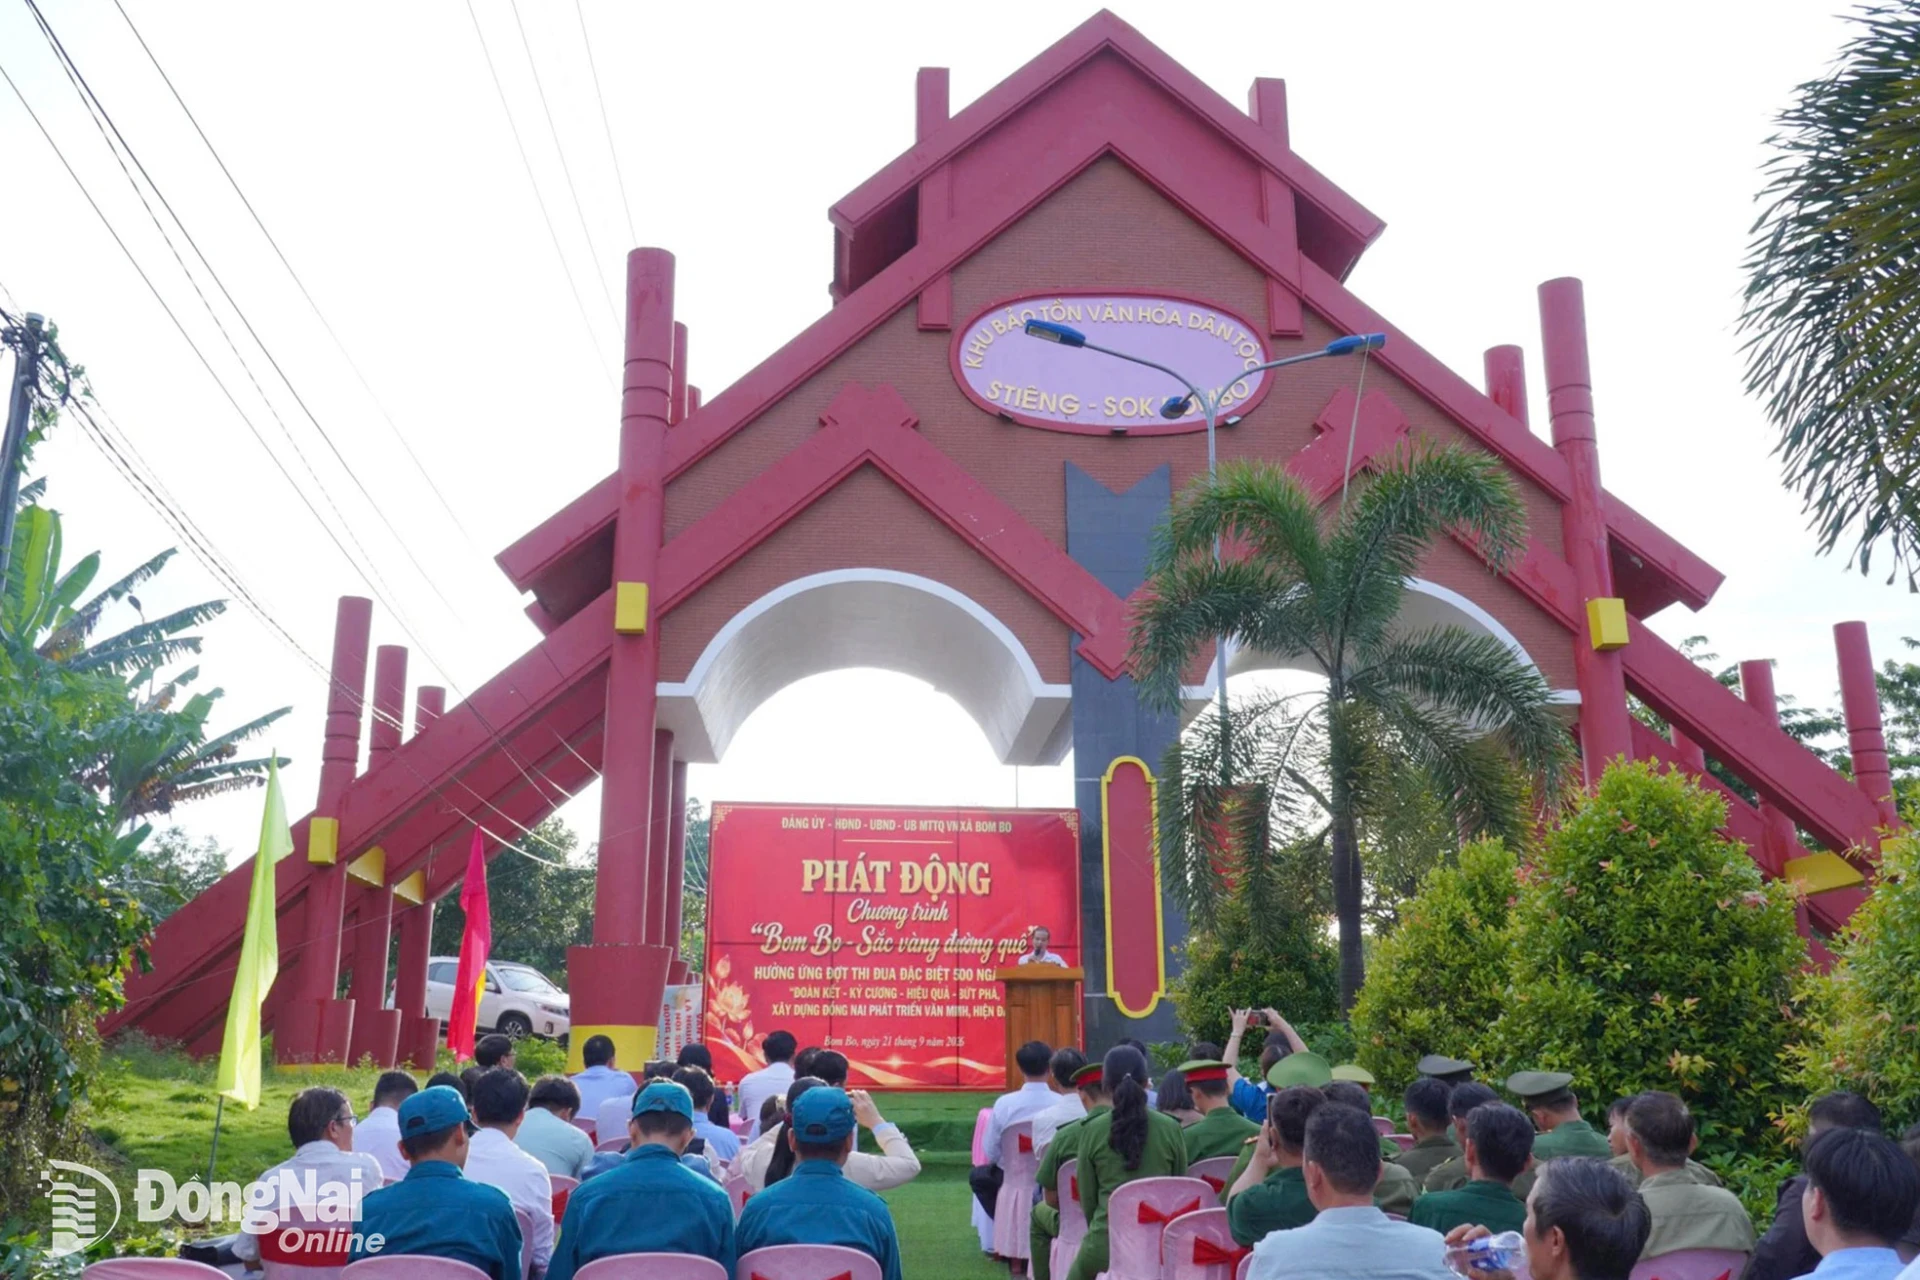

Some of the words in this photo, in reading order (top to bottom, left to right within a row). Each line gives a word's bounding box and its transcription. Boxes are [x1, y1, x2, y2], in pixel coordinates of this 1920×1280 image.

[965, 327, 994, 369] KHU
[991, 305, 1036, 336] BẢO
[1087, 301, 1134, 323] VĂN
[1137, 302, 1183, 327] HÓA
[1187, 311, 1235, 342] DÂN
[1230, 332, 1261, 371] TỘC
[985, 379, 1080, 416] STIÊNG
[1104, 396, 1154, 417] SOK
[782, 814, 809, 829] ĐẢNG
[812, 814, 825, 829] ỦY
[835, 818, 861, 830] HĐND
[870, 819, 895, 830] UBND
[904, 820, 917, 831] UB
[919, 821, 944, 832] MTTQ
[947, 821, 958, 832] VN
[960, 818, 972, 832] XÃ
[975, 821, 996, 832] BOM
[999, 822, 1012, 832] BO
[801, 852, 891, 893] PHÁT
[900, 853, 991, 902] ĐỘNG
[847, 898, 909, 929] Chương
[912, 901, 949, 921] trình
[751, 922, 808, 954] “Bom
[811, 924, 842, 956] Bo
[856, 925, 893, 956] Sắc
[898, 932, 941, 963] vàng
[944, 928, 995, 964] đường
[754, 962, 795, 980] HƯỞNG
[798, 964, 822, 980] ỨNG
[826, 966, 848, 983] ĐỢT
[851, 967, 870, 980] THI
[873, 968, 896, 980] ĐUA
[900, 965, 922, 983] ĐẶC
[925, 965, 950, 984] BIỆT
[953, 968, 973, 981] 500
[822, 984, 840, 998] KẾT
[865, 986, 897, 999] CƯƠNG
[906, 986, 928, 1001] HIỆU
[930, 985, 950, 1001] QUẢ
[959, 986, 976, 999] BỨT
[772, 1001, 792, 1016] XÂY
[794, 1003, 820, 1018] DỰNG
[822, 1001, 848, 1016] ĐỒNG
[850, 1004, 867, 1016] NAI
[869, 1002, 893, 1016] PHÁT
[895, 1000, 922, 1016] TRIỂN
[924, 1003, 944, 1017] VĂN
[946, 1005, 971, 1018] MINH,
[973, 1003, 994, 1019] HIỆN
[824, 1035, 843, 1046] Bom
[862, 1036, 880, 1048] ngày
[882, 1036, 892, 1046] 21
[894, 1036, 917, 1048] tháng
[919, 1037, 925, 1047] 9
[926, 1036, 944, 1047] năm
